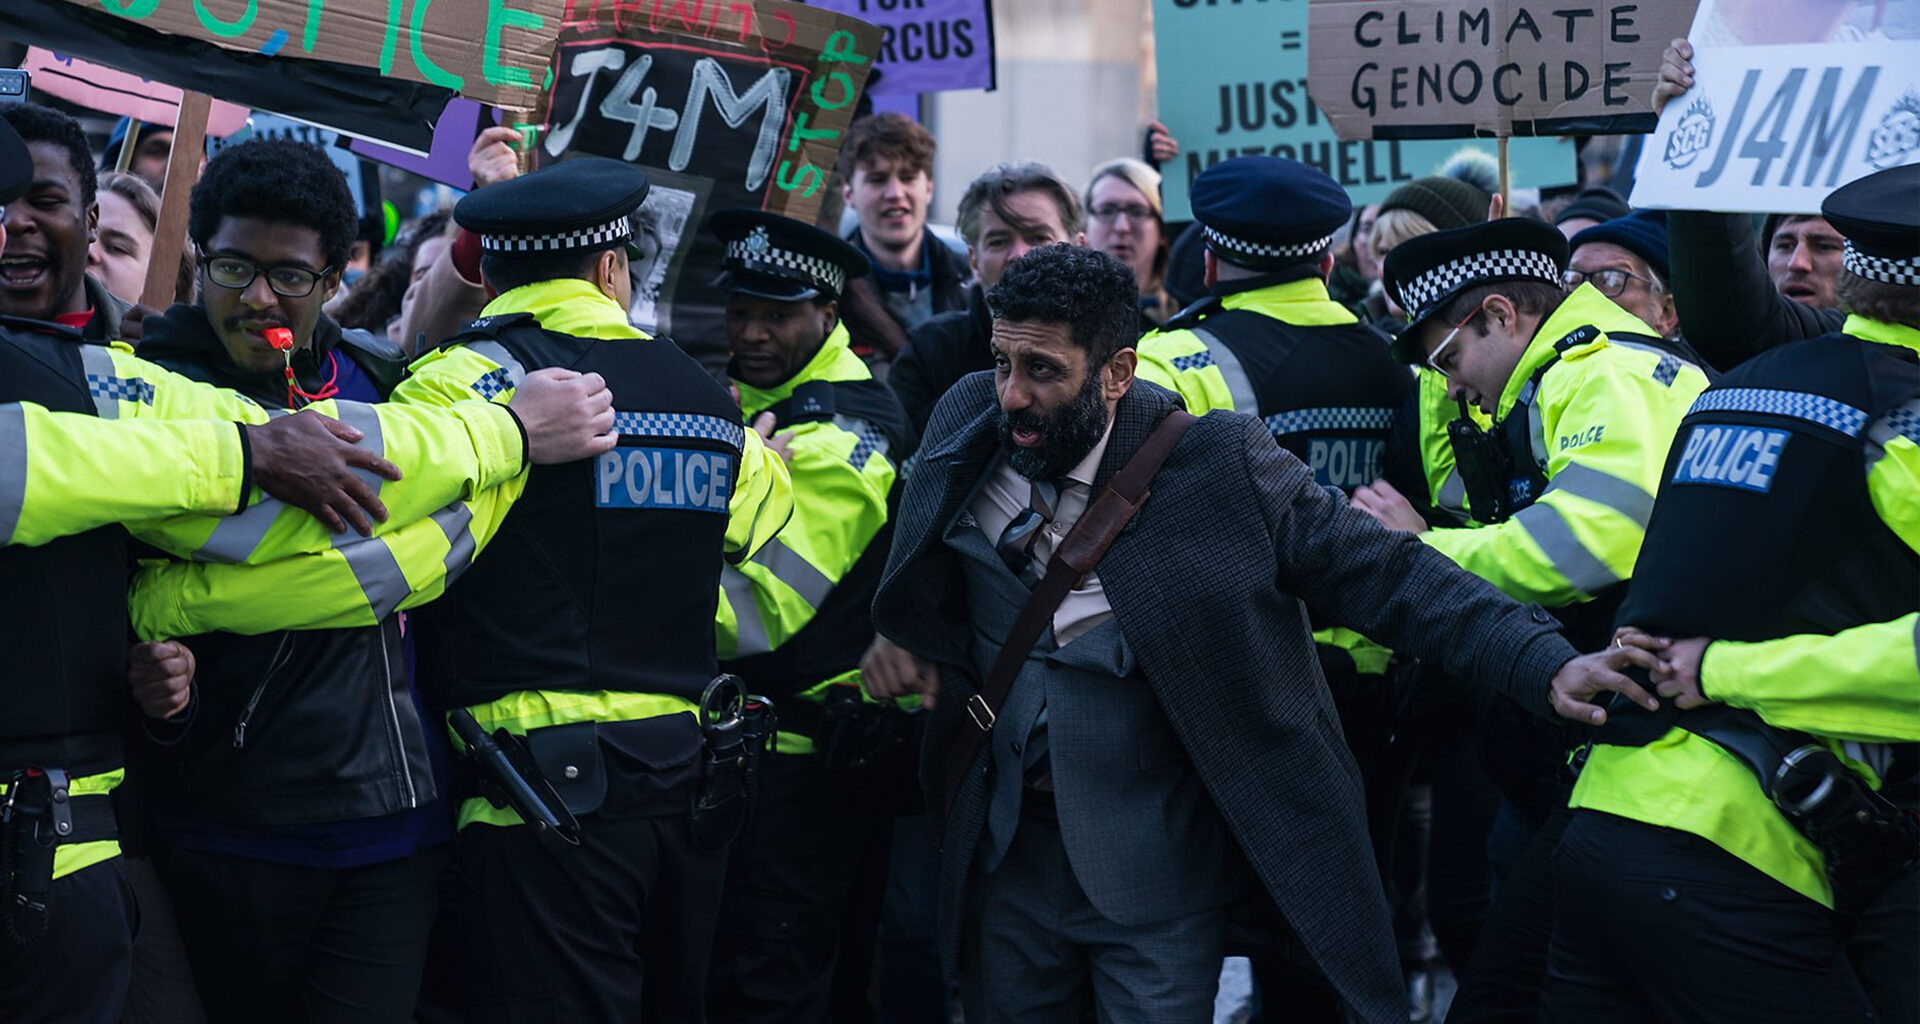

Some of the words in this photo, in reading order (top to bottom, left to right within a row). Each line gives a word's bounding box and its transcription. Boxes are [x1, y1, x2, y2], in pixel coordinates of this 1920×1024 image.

[1355, 5, 1641, 47] CLIMATE
[776, 29, 868, 197] STOP
[1352, 60, 1632, 117] GENOCIDE
[545, 48, 791, 191] J4M
[1694, 65, 1882, 188] J4M
[600, 450, 728, 509] POLICE
[1674, 427, 1786, 488] POLICE
